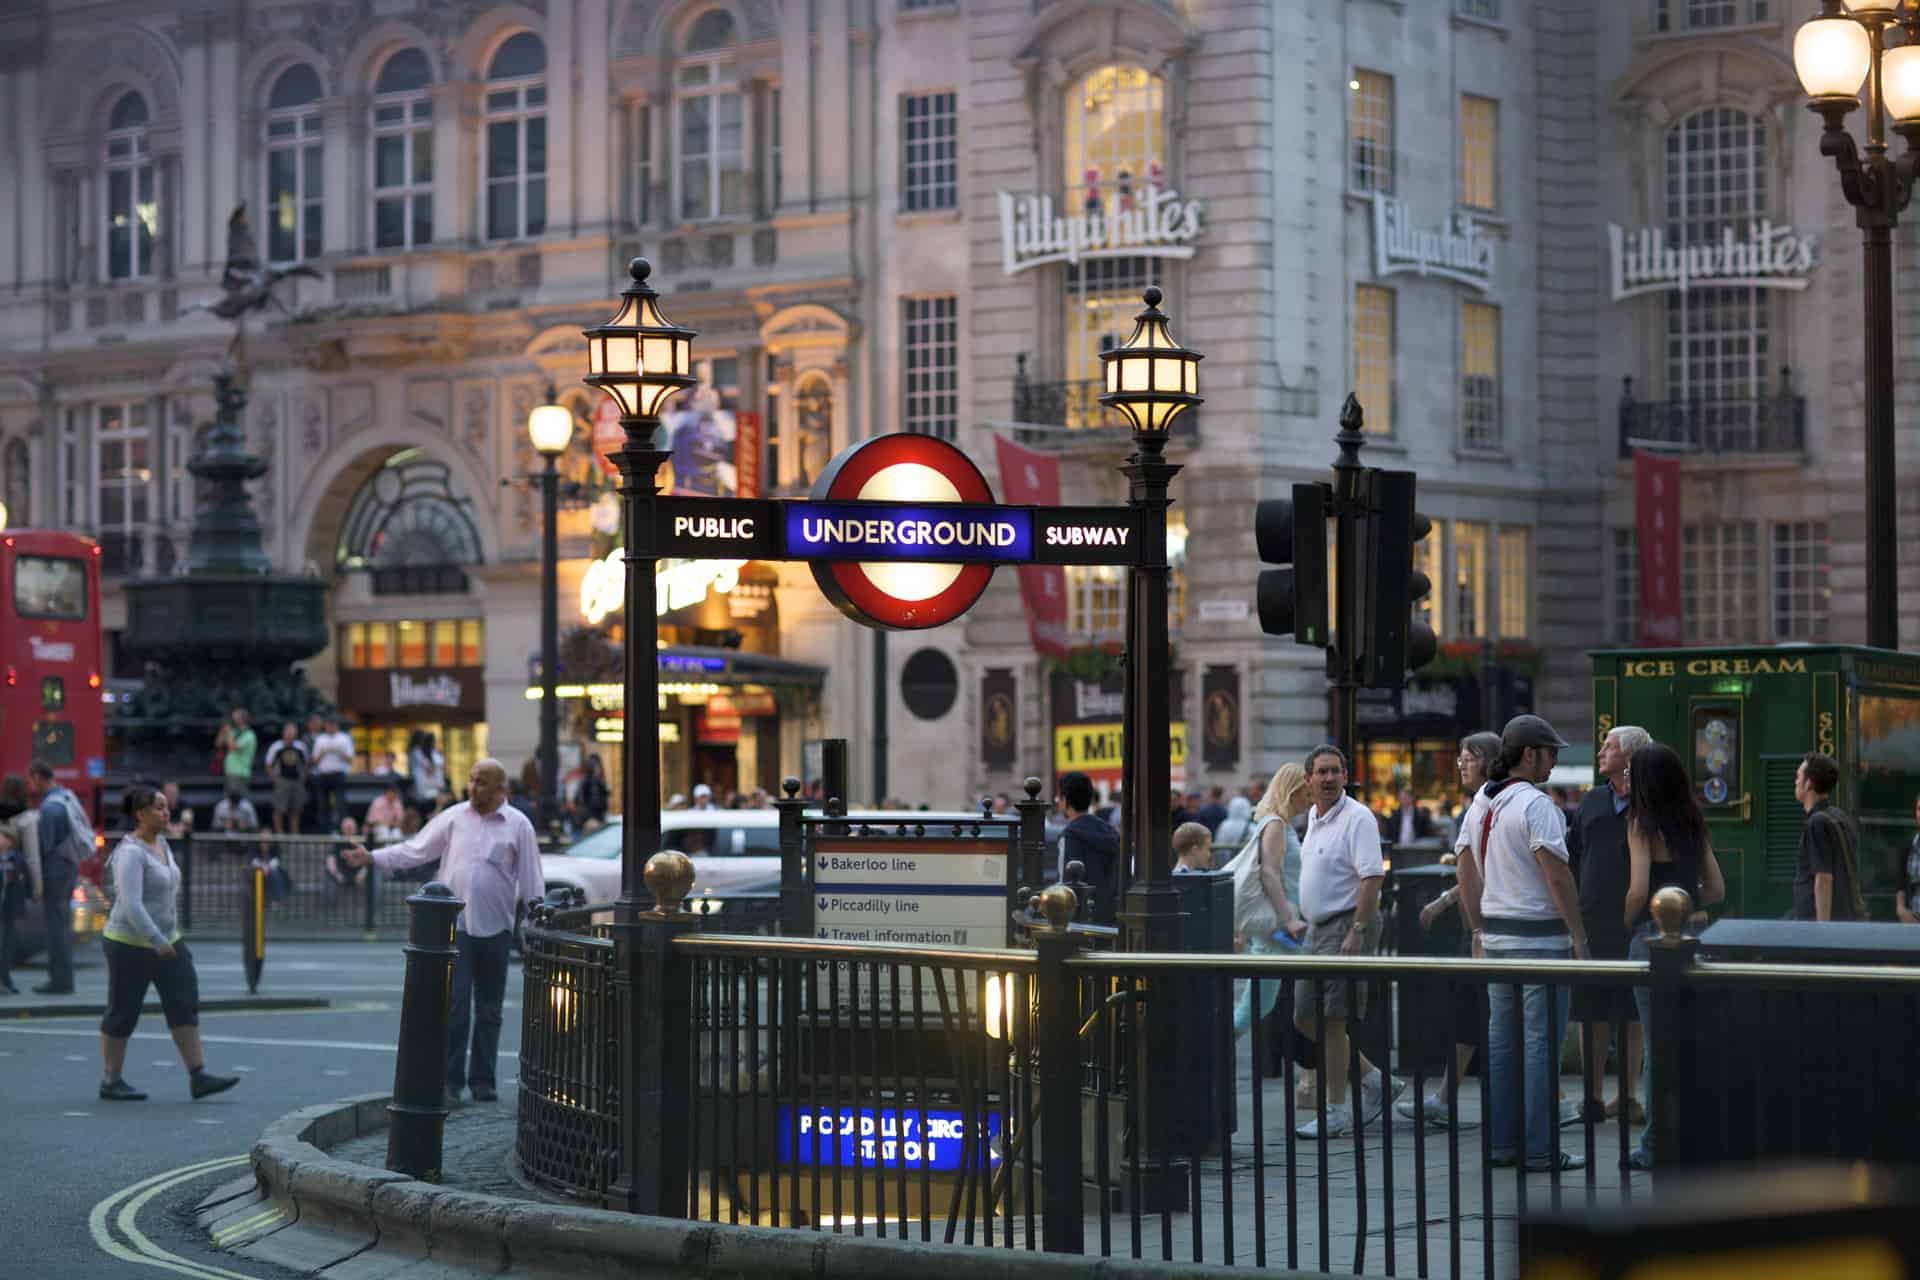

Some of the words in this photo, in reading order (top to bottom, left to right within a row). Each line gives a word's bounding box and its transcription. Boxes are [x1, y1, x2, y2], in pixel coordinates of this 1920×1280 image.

[674, 516, 755, 540] PUBLIC
[802, 518, 1017, 548] UNDERGROUND
[1045, 526, 1130, 546] SUBWAY
[1623, 660, 1677, 678] ICE
[1687, 656, 1808, 677] CREAM
[1062, 735, 1075, 762] 1
[830, 857, 888, 871] Bakerloo
[892, 858, 917, 871] line
[830, 898, 891, 915] Piccadilly
[895, 900, 920, 912] line
[831, 928, 871, 942] Travel
[874, 929, 951, 944] information
